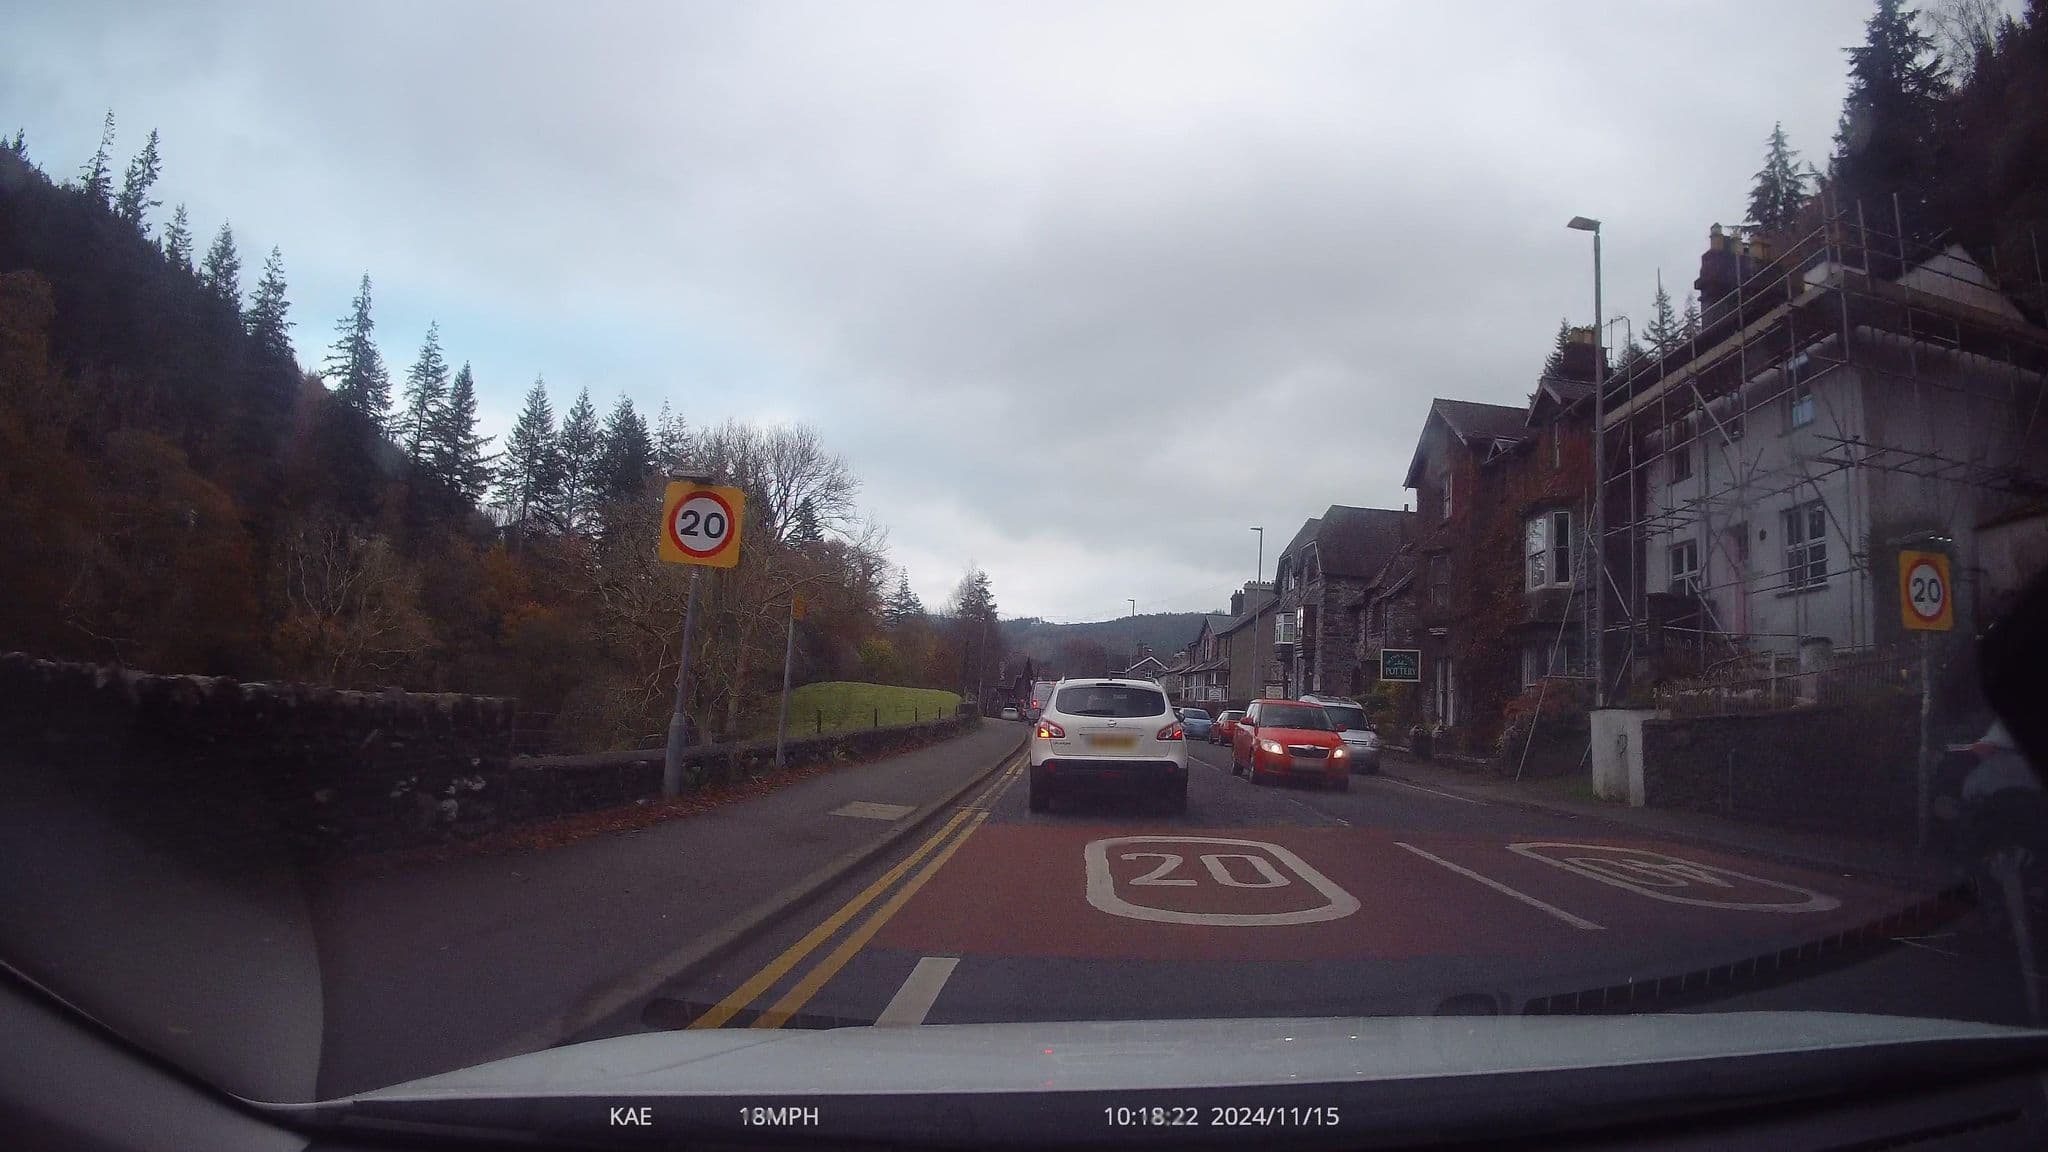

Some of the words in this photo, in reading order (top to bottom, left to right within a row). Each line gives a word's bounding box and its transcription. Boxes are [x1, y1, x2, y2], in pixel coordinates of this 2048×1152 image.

[680, 509, 725, 539] 20
[1912, 577, 1941, 603] 20
[1386, 667, 1415, 676] POTTERY
[1121, 853, 1292, 888] 20
